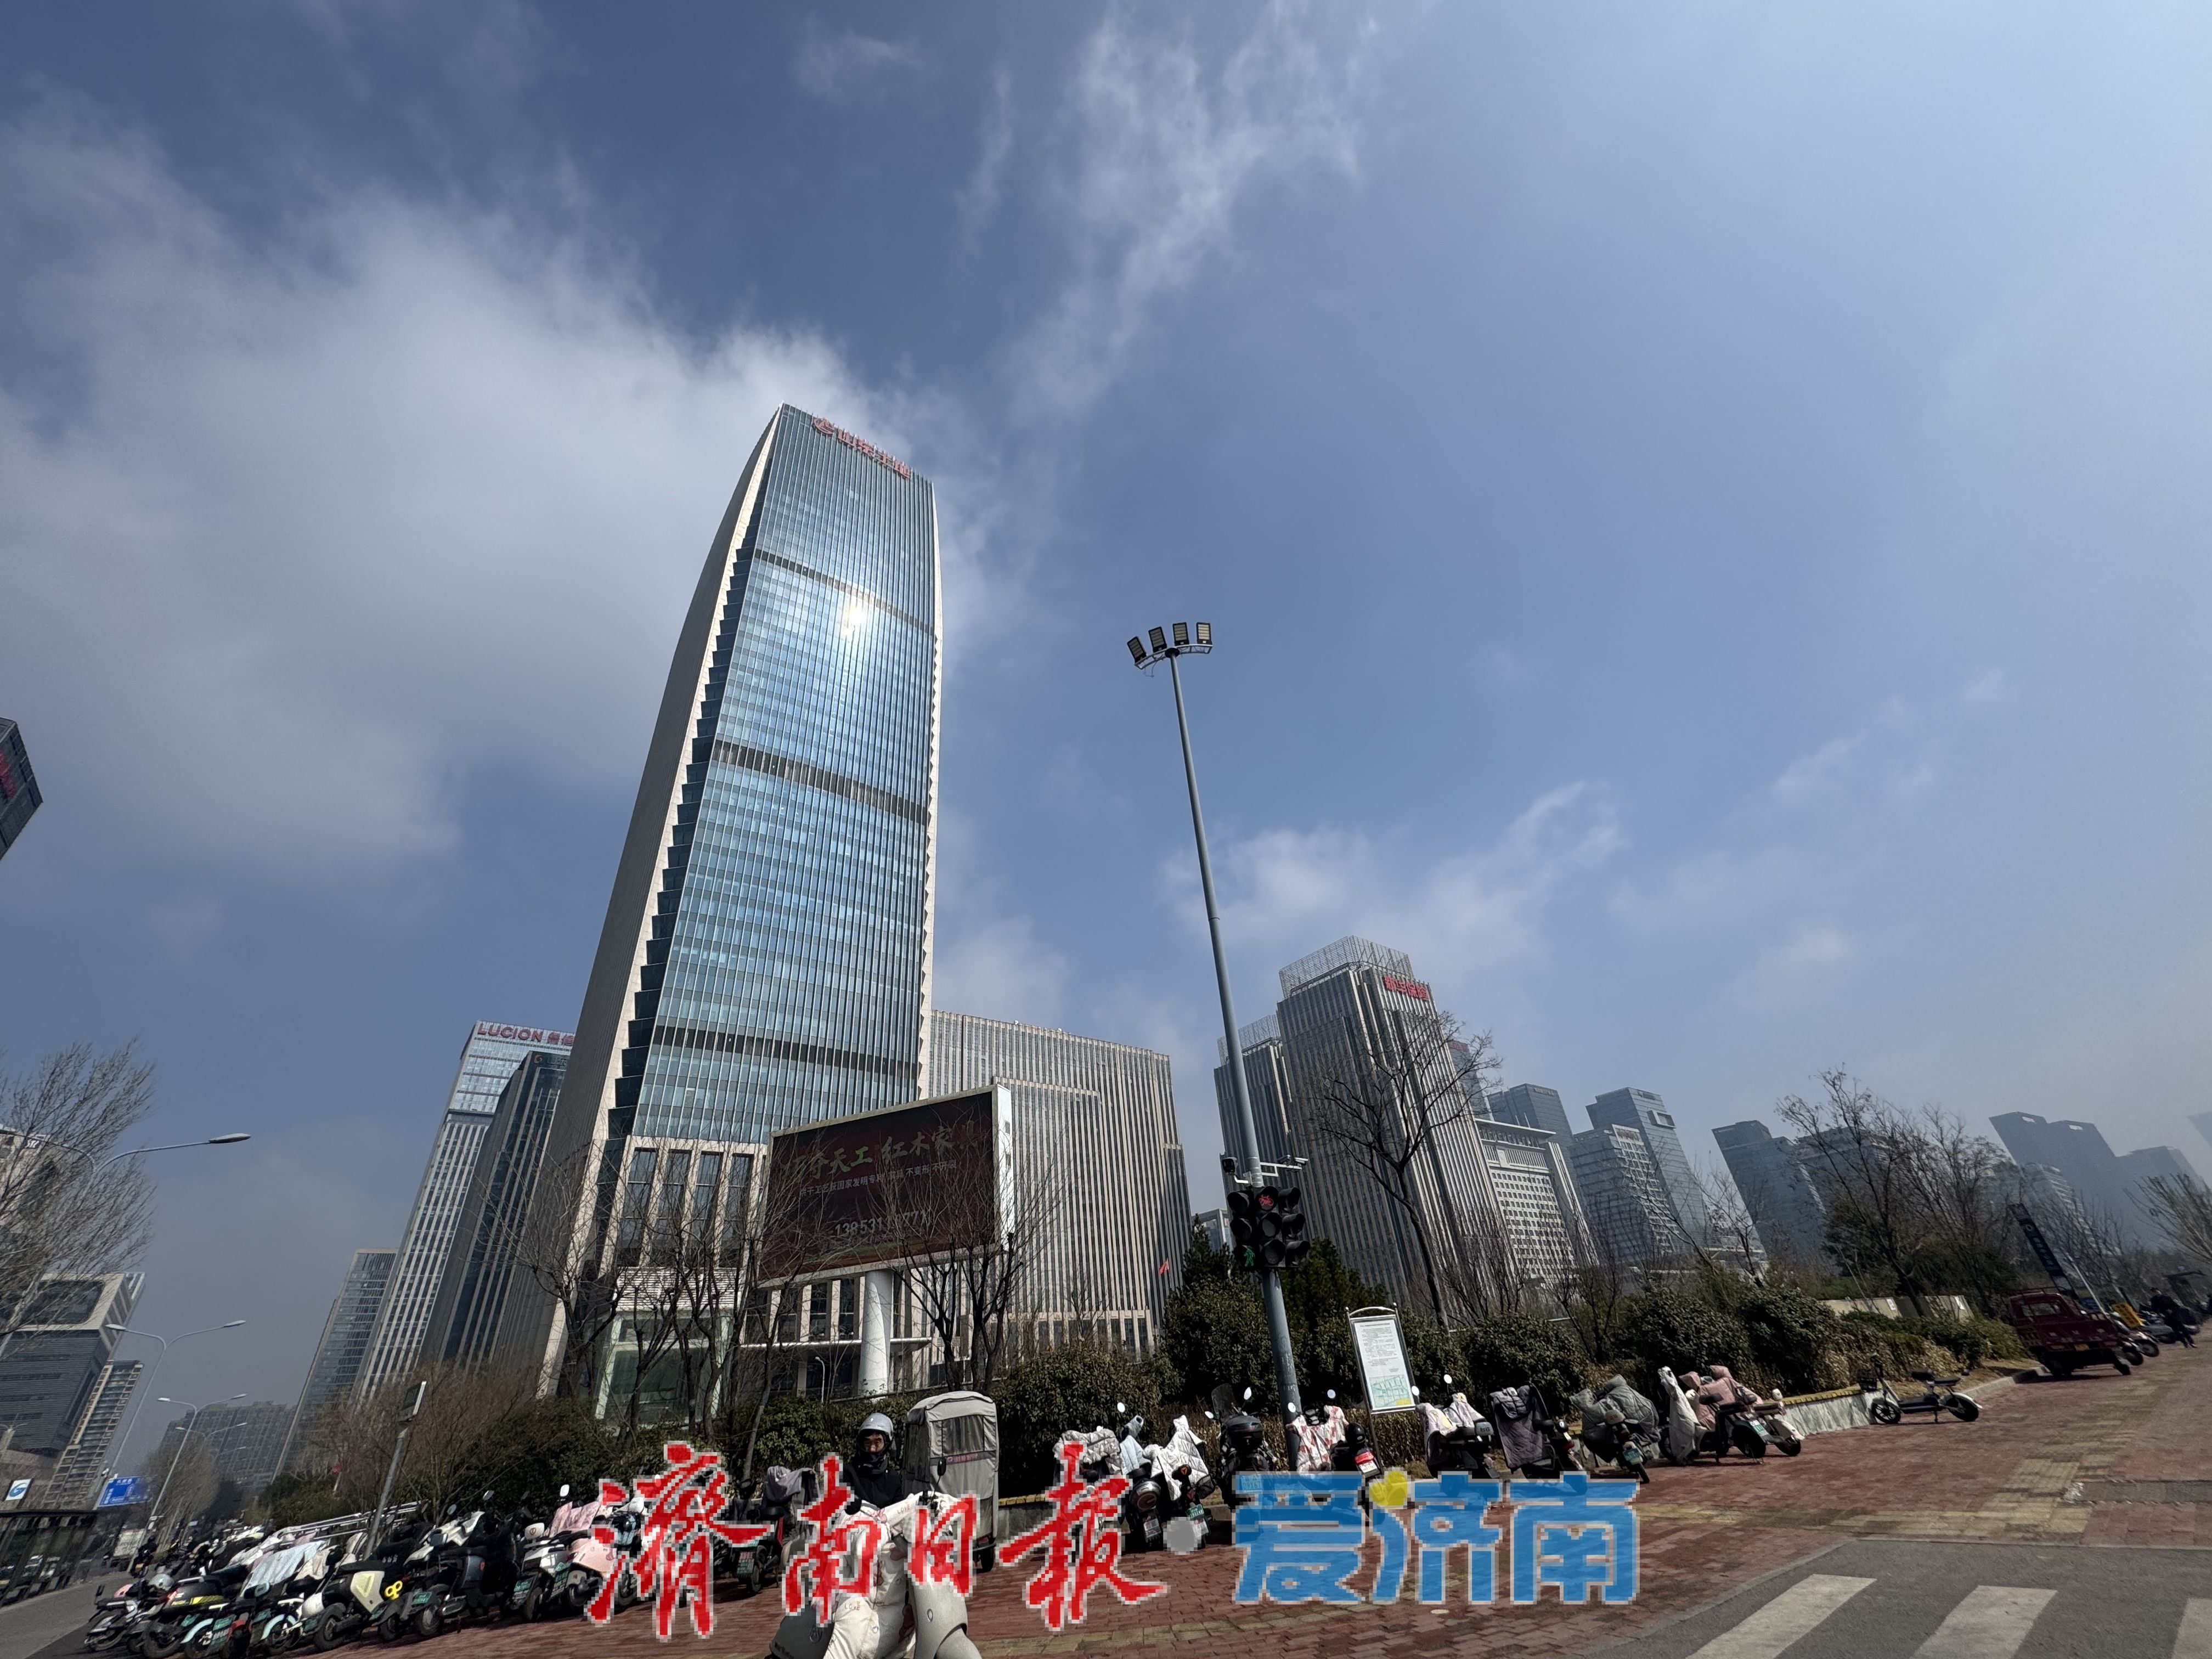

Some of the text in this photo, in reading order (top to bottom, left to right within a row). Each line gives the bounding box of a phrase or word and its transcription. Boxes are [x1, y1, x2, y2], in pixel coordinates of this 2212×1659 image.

[837, 428, 911, 479] 山东土地
[1384, 974, 1430, 1001] 新华保险
[477, 1022, 544, 1042] LUCION
[906, 1164, 930, 1177] 不变形
[897, 1504, 911, 1515] LOVE
